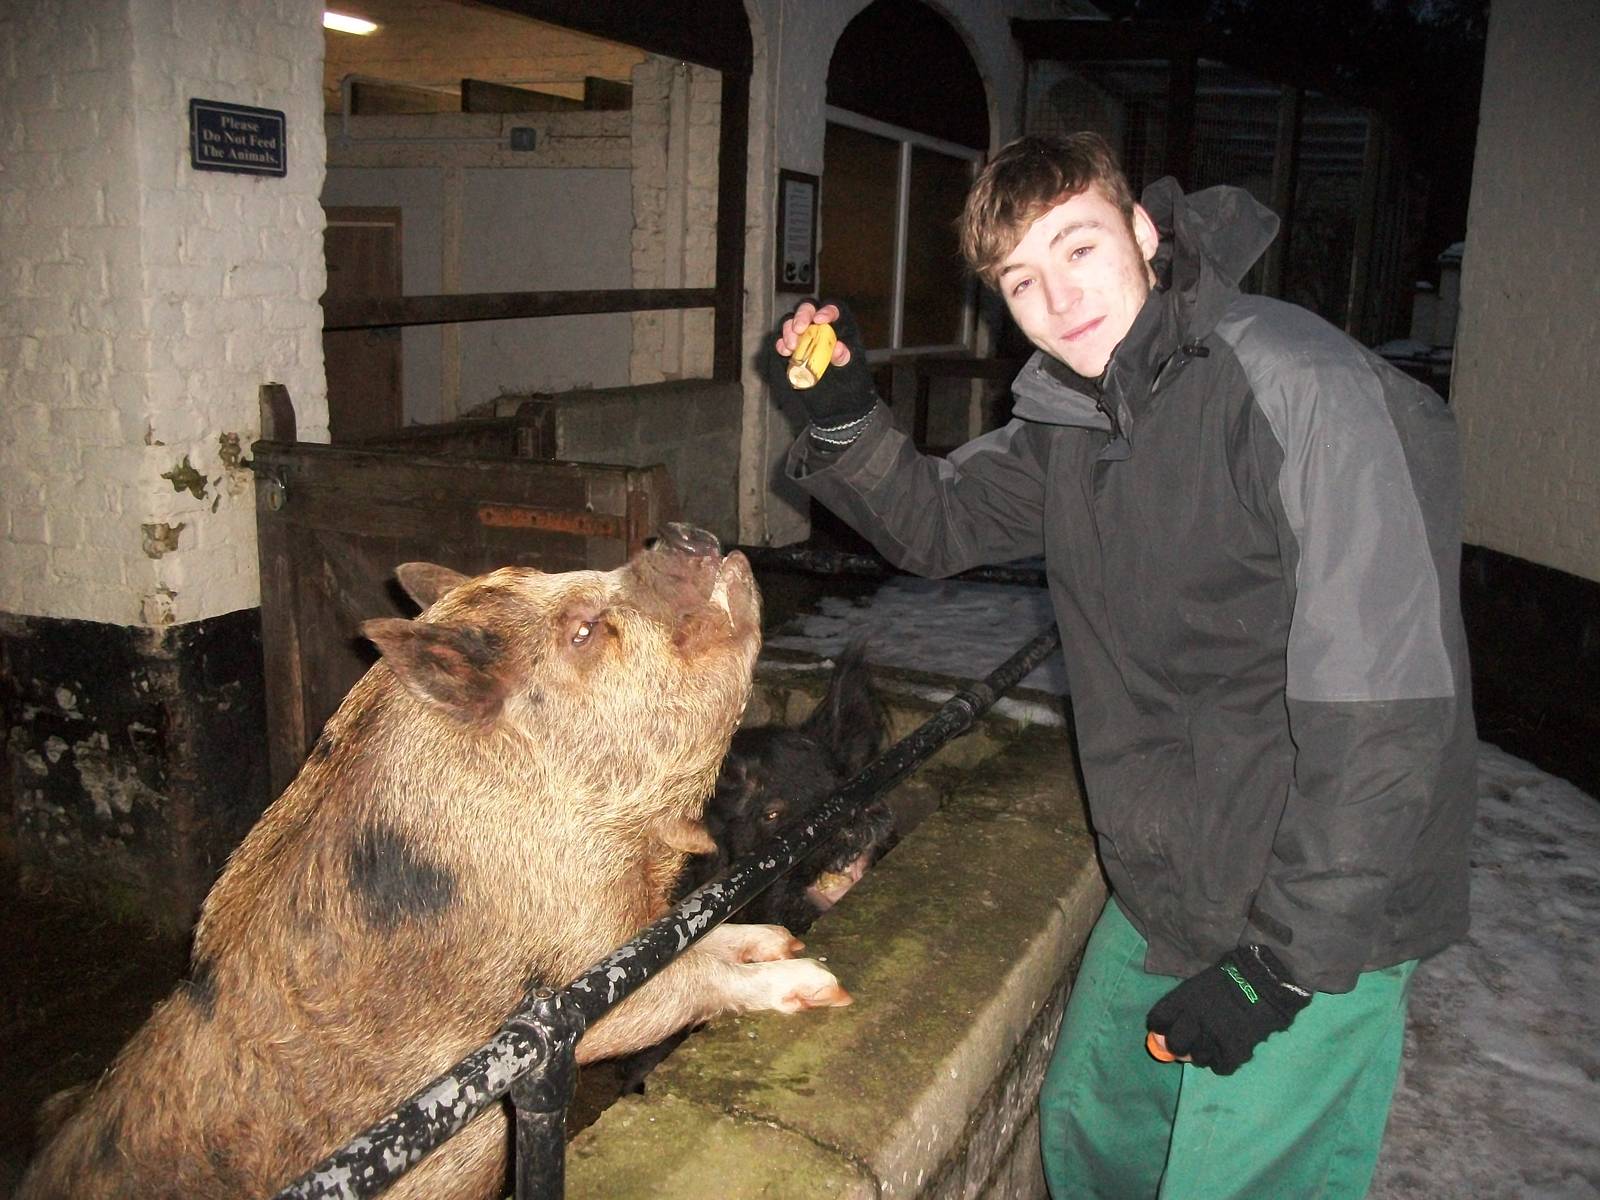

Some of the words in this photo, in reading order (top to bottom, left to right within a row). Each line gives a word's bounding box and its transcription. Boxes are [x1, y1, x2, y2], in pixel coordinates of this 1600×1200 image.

[221, 116, 258, 131] Please
[203, 130, 220, 142] Do
[224, 131, 246, 144] Not
[250, 135, 276, 148] Feed
[203, 144, 224, 158] The
